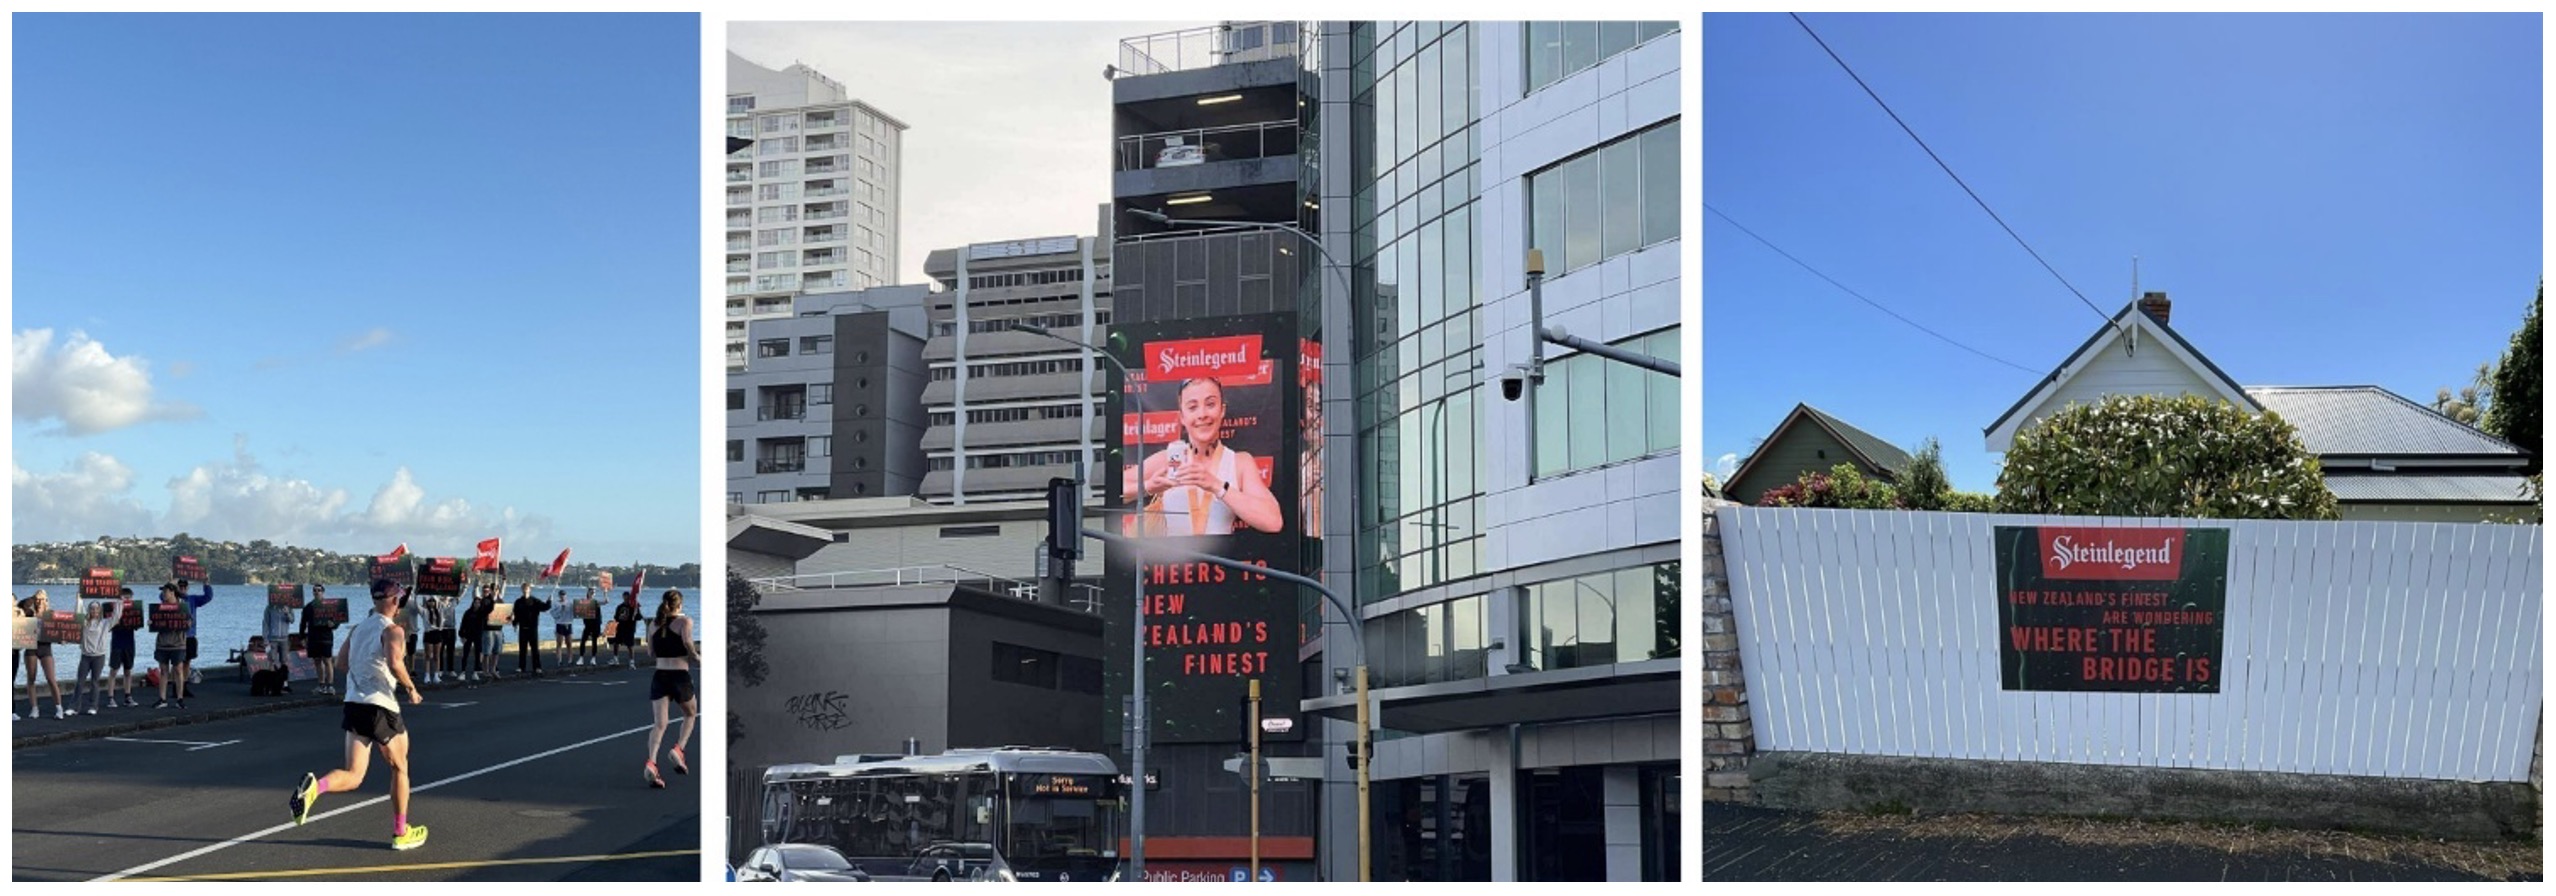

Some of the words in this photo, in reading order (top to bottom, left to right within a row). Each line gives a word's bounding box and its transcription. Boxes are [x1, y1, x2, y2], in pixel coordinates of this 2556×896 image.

[1158, 343, 1247, 374] Steinlegend
[2050, 534, 2172, 570] Steinlegend
[2009, 591, 2037, 605] NEW
[2043, 591, 2116, 606] ZEALAND'S
[2121, 593, 2168, 606] FINEST
[2102, 611, 2128, 624] ARE
[2134, 611, 2213, 625] WONDERING
[2010, 627, 2098, 652] WHERE
[2109, 628, 2156, 652] THE
[1184, 652, 1268, 676] FINEST
[2083, 657, 2175, 682] BRIDGE
[2185, 657, 2211, 682] IS
[1051, 777, 1074, 786] Sorry
